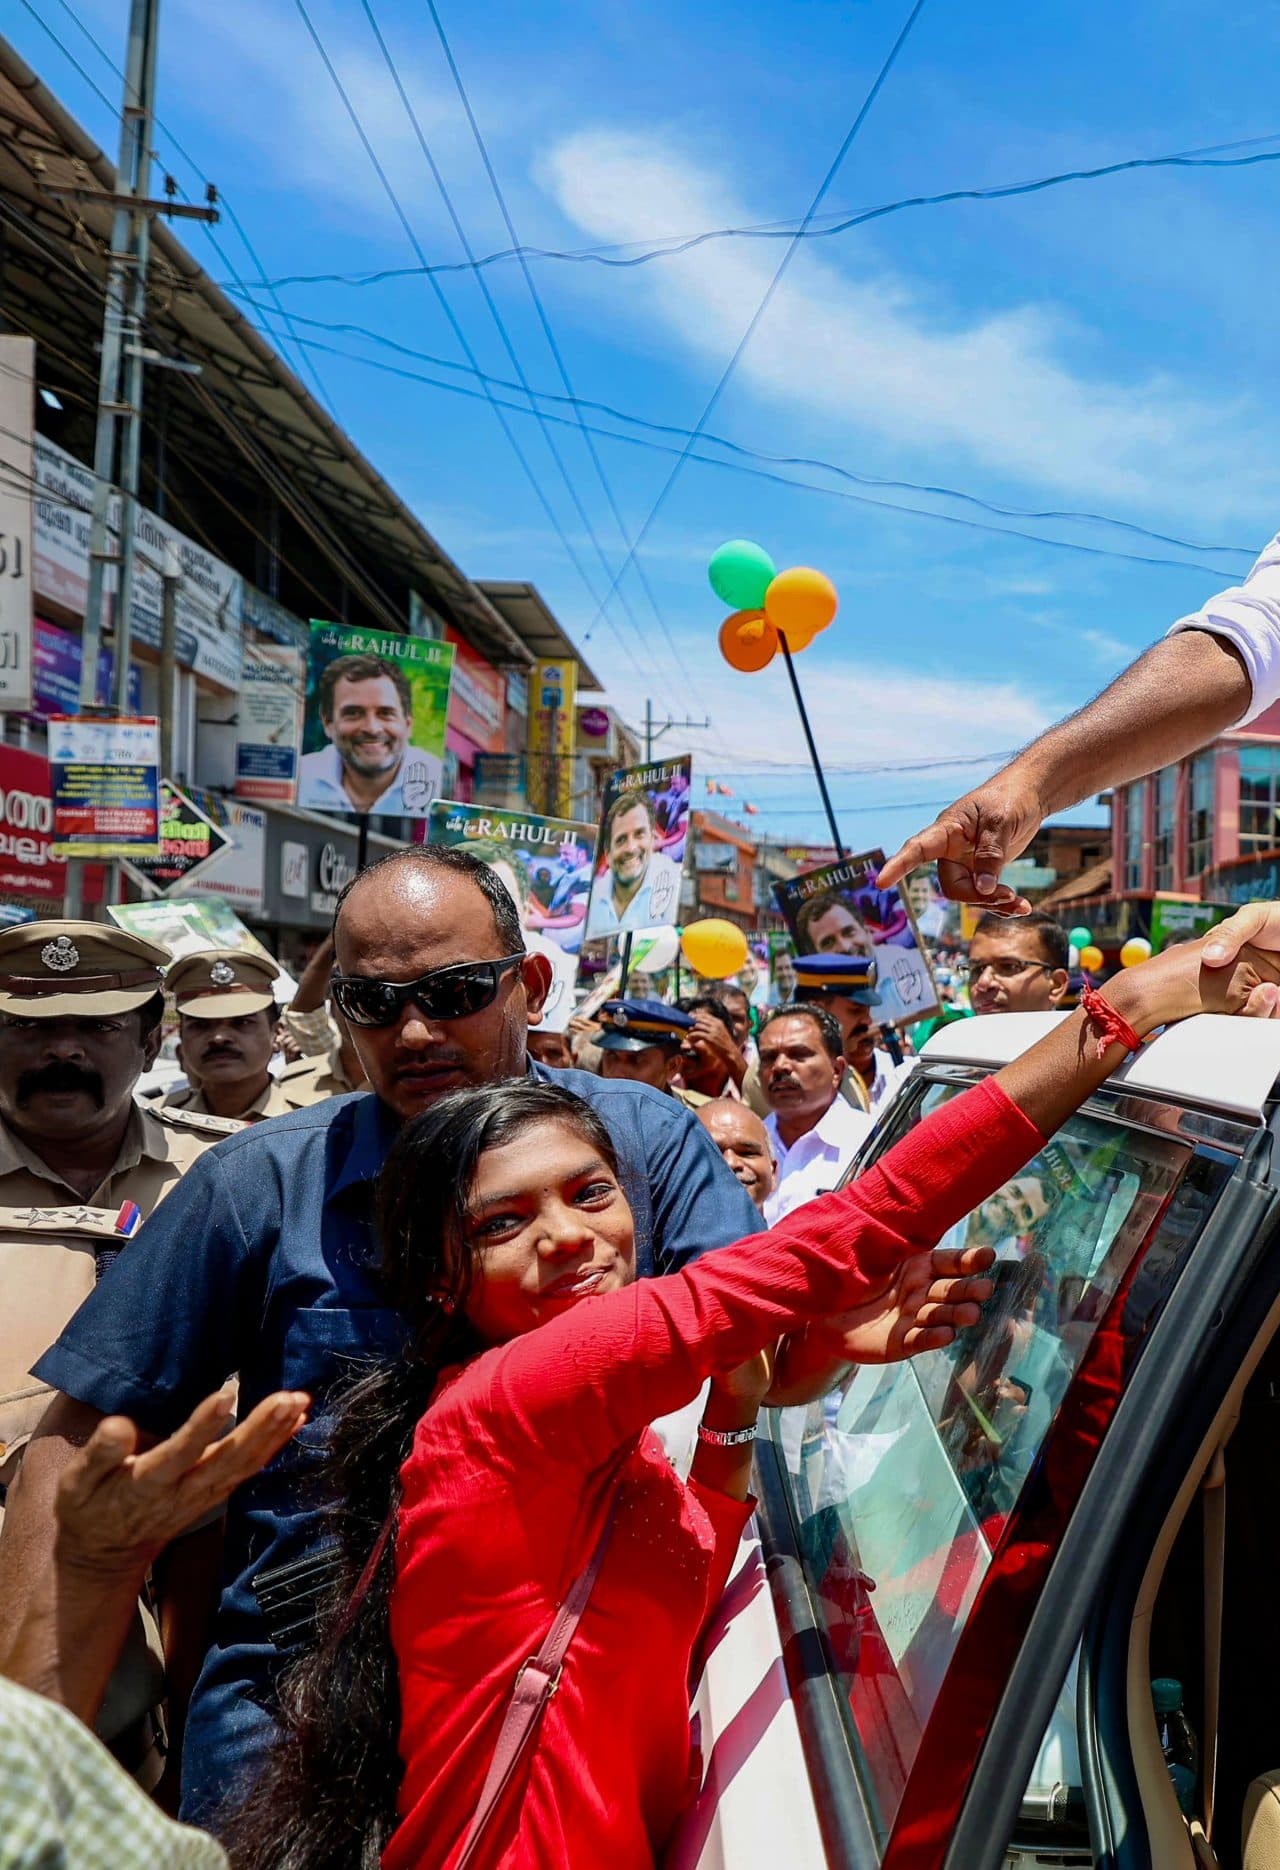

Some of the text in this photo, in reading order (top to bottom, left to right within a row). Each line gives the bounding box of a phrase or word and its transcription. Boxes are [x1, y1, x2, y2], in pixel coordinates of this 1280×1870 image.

[351, 634, 424, 661] RAHUL
[625, 767, 669, 788] RAHUL
[477, 818, 556, 845] RAHUL
[560, 830, 578, 846] JI
[804, 865, 861, 893] RAHUL
